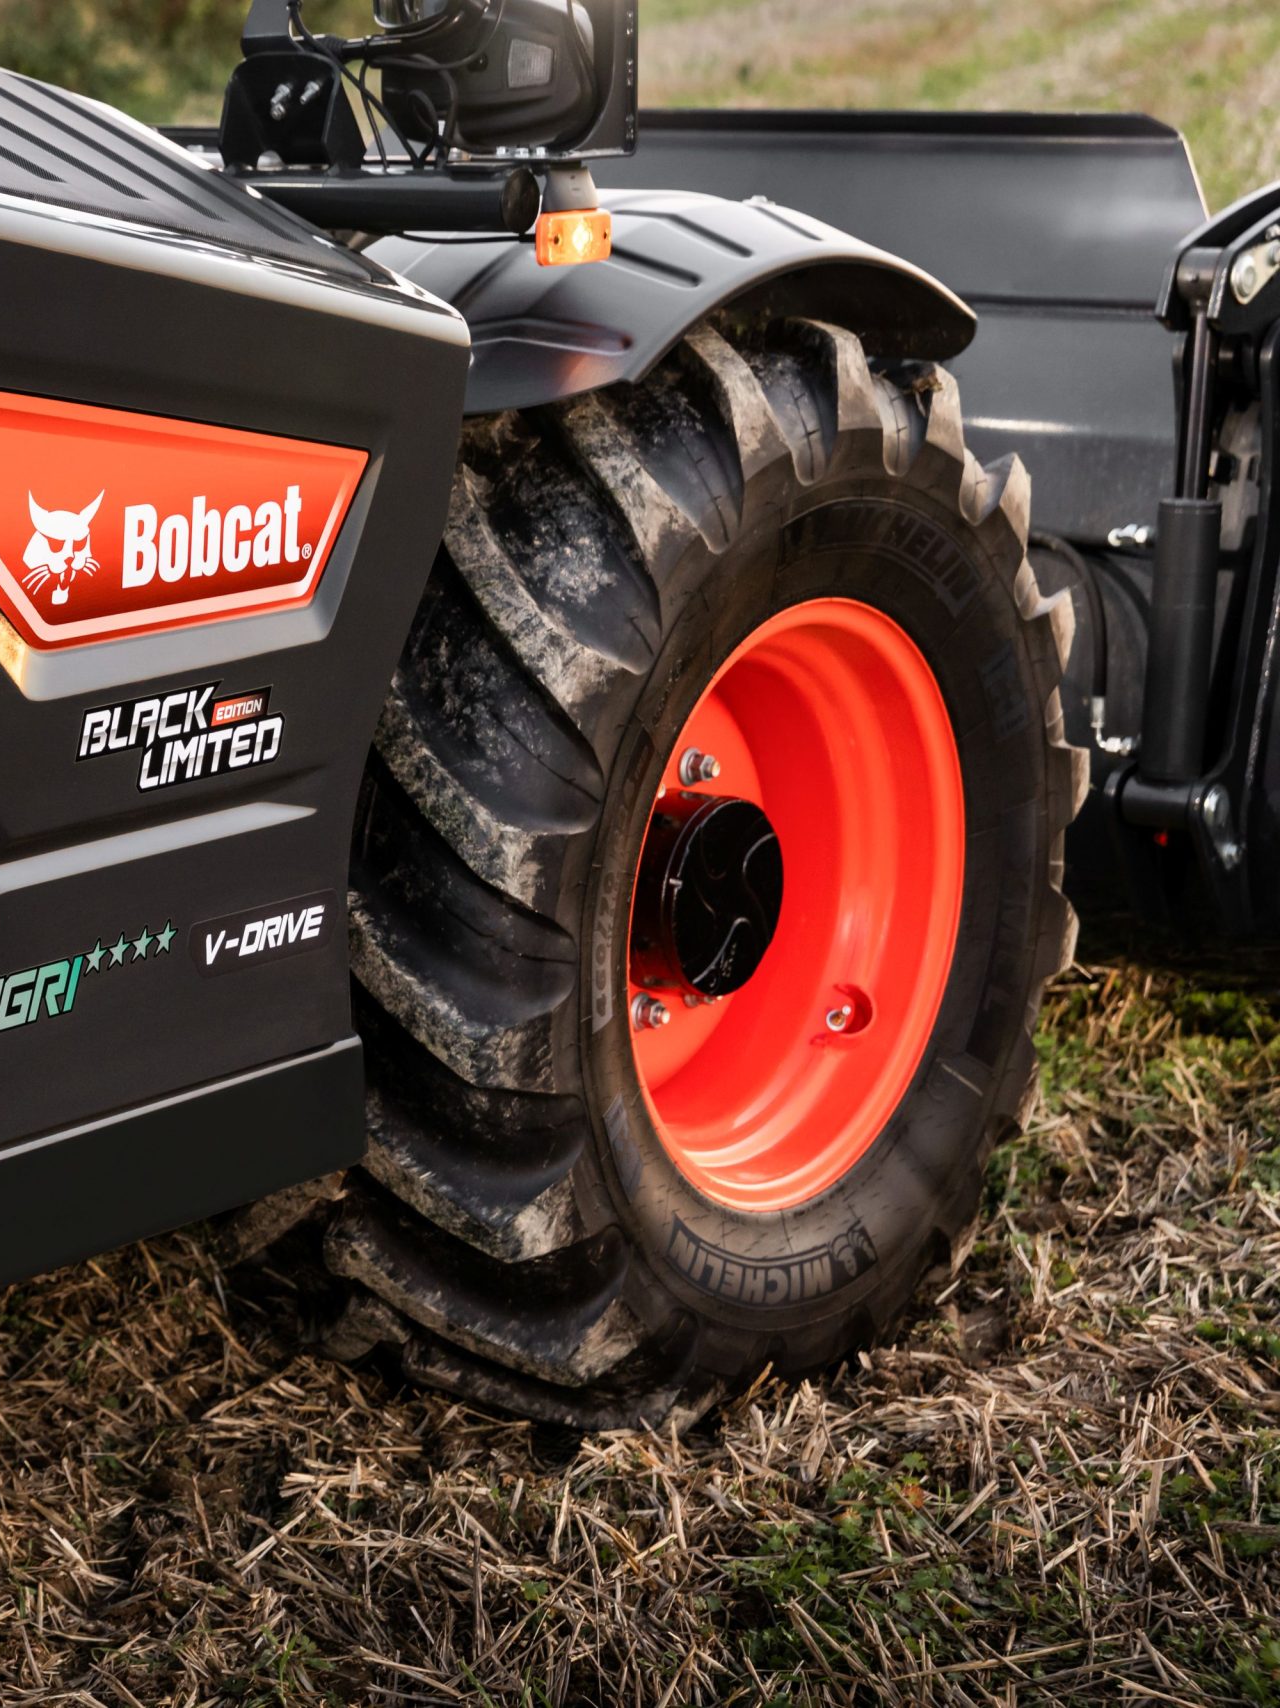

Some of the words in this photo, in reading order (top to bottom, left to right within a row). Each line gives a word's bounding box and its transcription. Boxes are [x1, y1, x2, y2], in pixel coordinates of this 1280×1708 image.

[79, 686, 215, 757] BLACK
[215, 697, 263, 721] EDITION
[139, 716, 283, 790] LIMITED
[205, 904, 325, 965] V-DRIVE
[671, 1227, 833, 1303] MICHELIN
